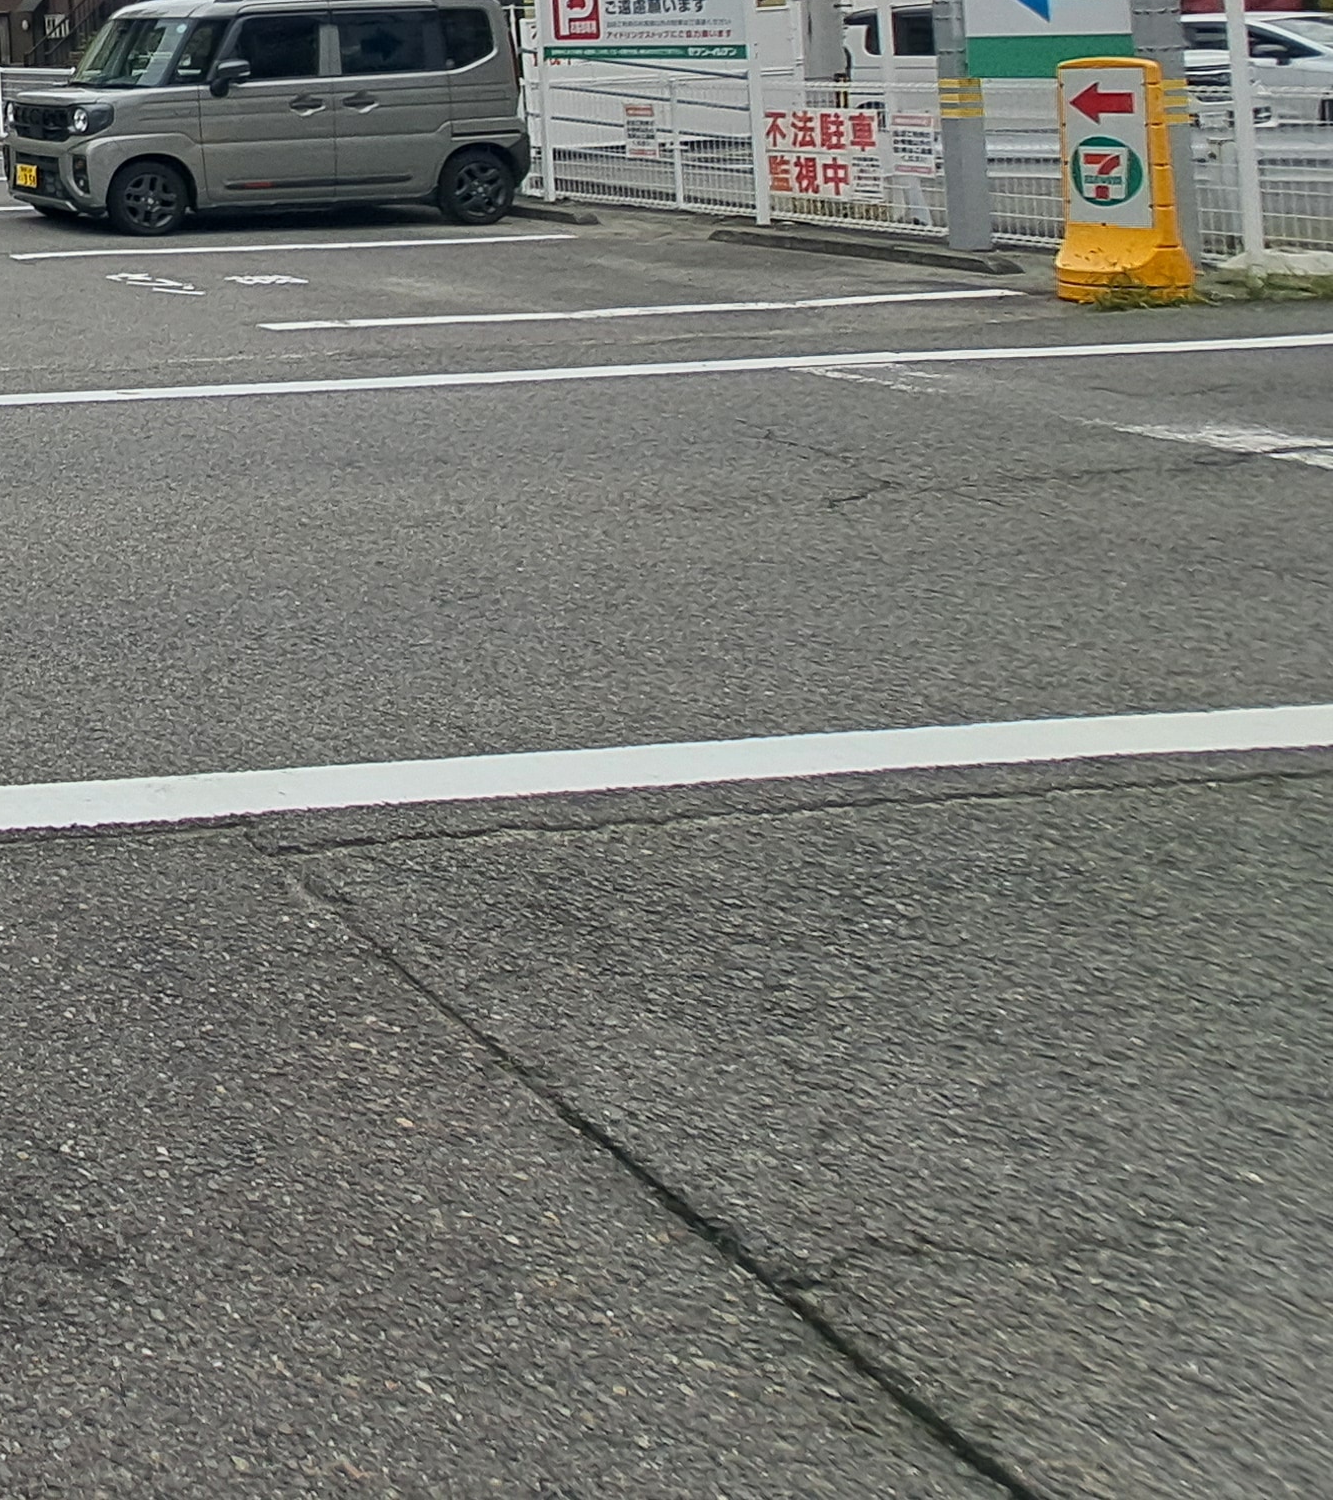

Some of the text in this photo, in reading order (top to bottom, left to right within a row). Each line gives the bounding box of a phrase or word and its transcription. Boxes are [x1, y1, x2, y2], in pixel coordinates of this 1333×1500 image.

[764, 110, 877, 152] 不法駐車
[768, 155, 850, 196] 監視中
